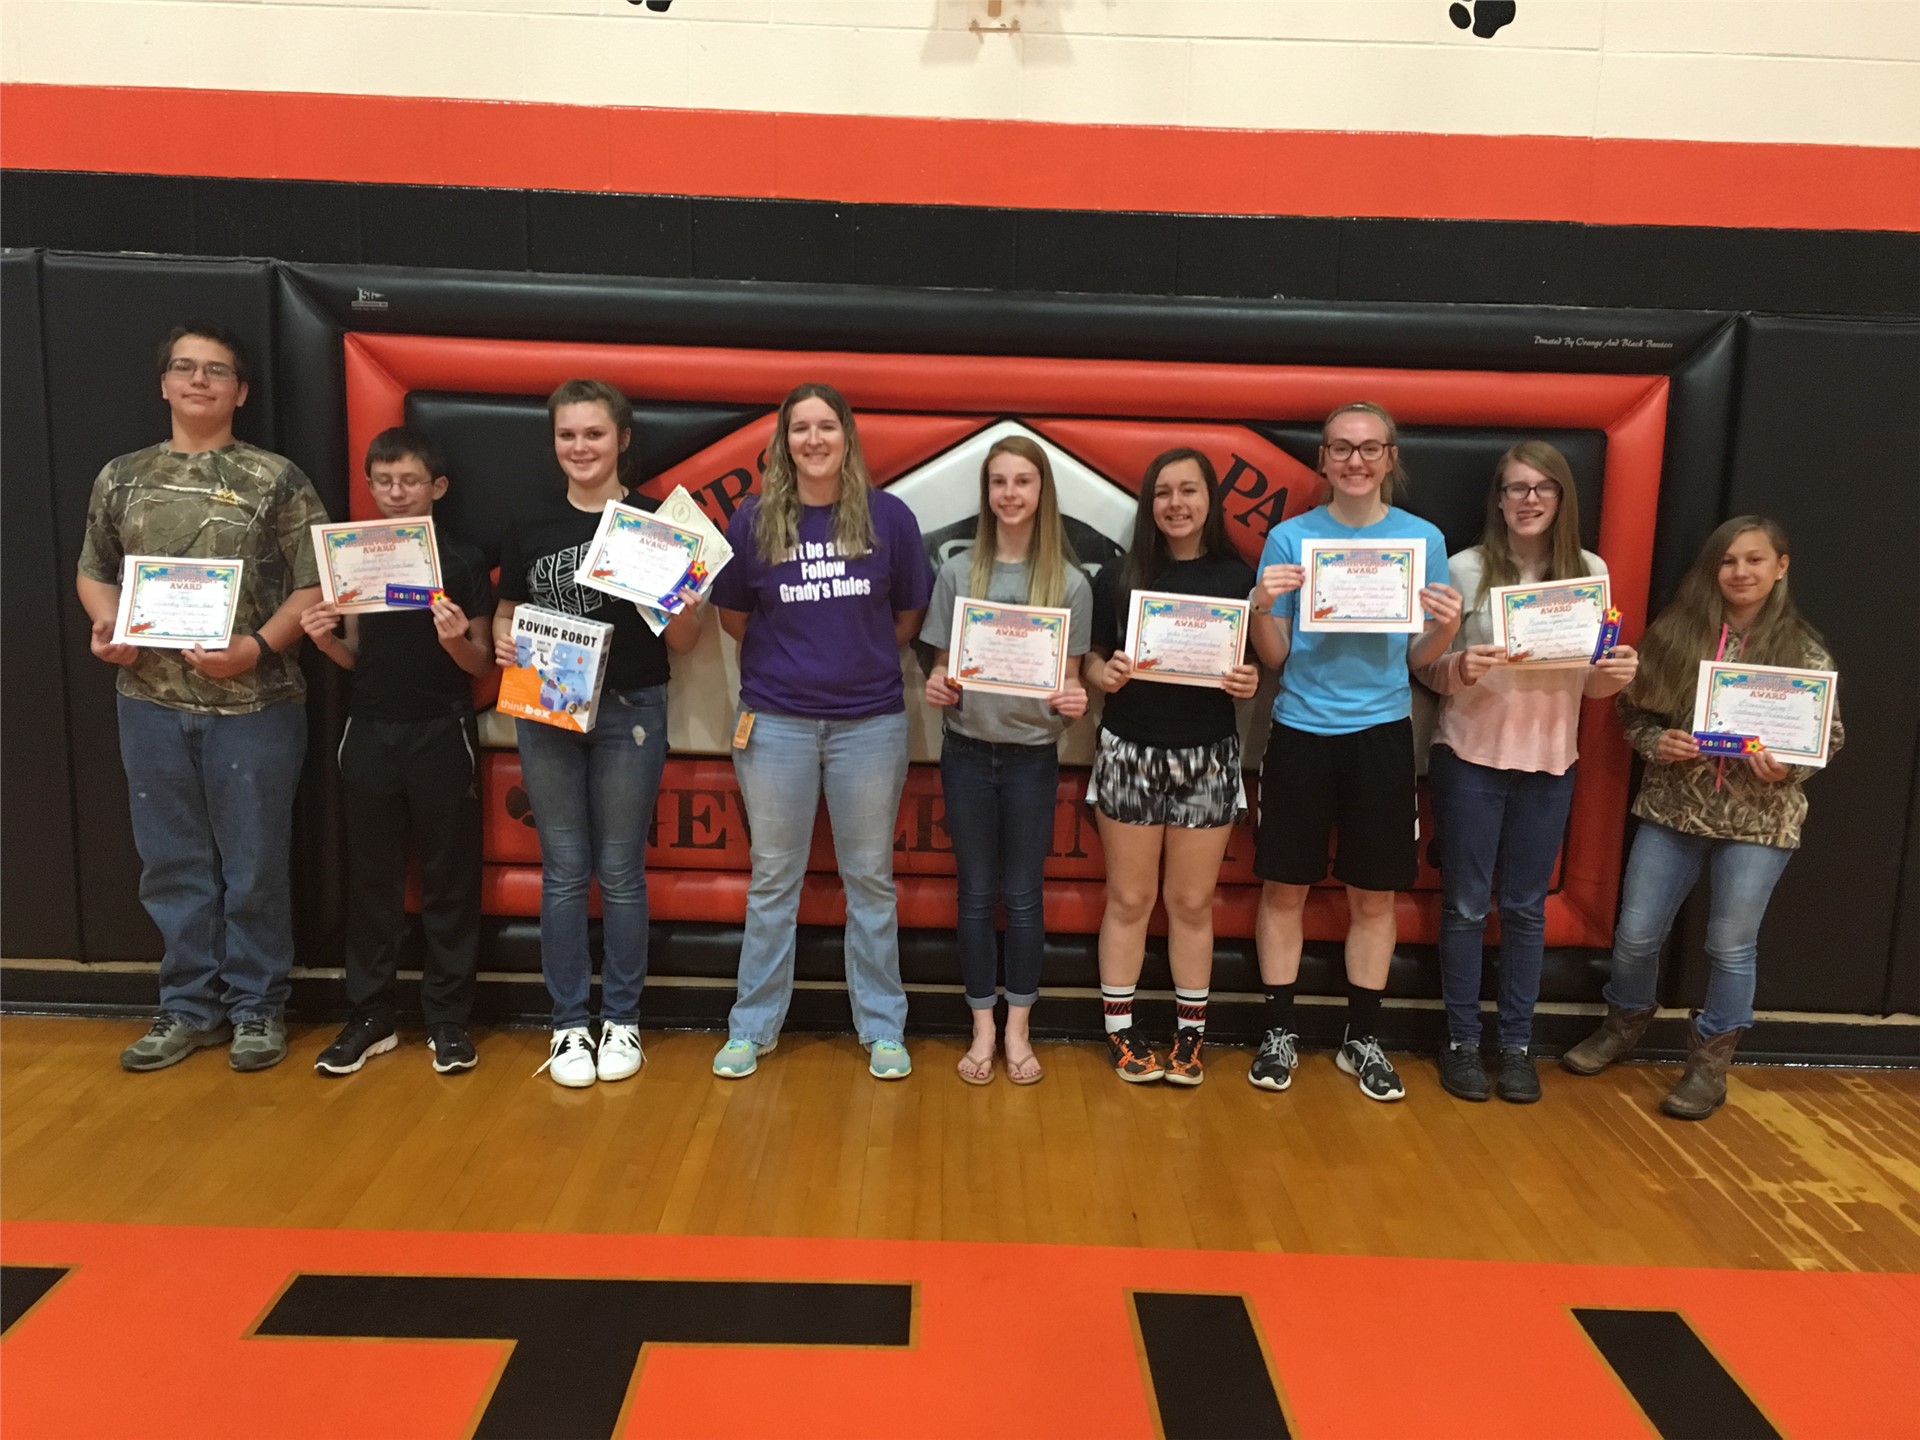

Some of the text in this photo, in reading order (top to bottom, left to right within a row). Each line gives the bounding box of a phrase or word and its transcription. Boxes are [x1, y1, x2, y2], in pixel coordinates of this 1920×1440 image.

[1563, 337, 1575, 348] By
[1575, 337, 1602, 349] Orange
[1603, 338, 1620, 349] And
[1621, 338, 1643, 347] Black
[362, 545, 396, 554] AWARD
[639, 538, 669, 551] AWARD
[805, 541, 824, 560] be
[825, 541, 835, 558] a
[801, 560, 846, 580] Follow
[1346, 567, 1378, 575] AWARD
[169, 582, 202, 591] AWARD
[779, 576, 871, 603] Grady's Rules
[1540, 605, 1572, 615] AWARD
[1174, 620, 1207, 630] AWARD
[518, 618, 559, 639] ROVING
[561, 629, 598, 648] ROBOT
[995, 628, 1028, 638] AWARD
[1750, 690, 1787, 701] AWARD
[501, 699, 551, 719] thinkbox
[1104, 1001, 1133, 1016] NIK
